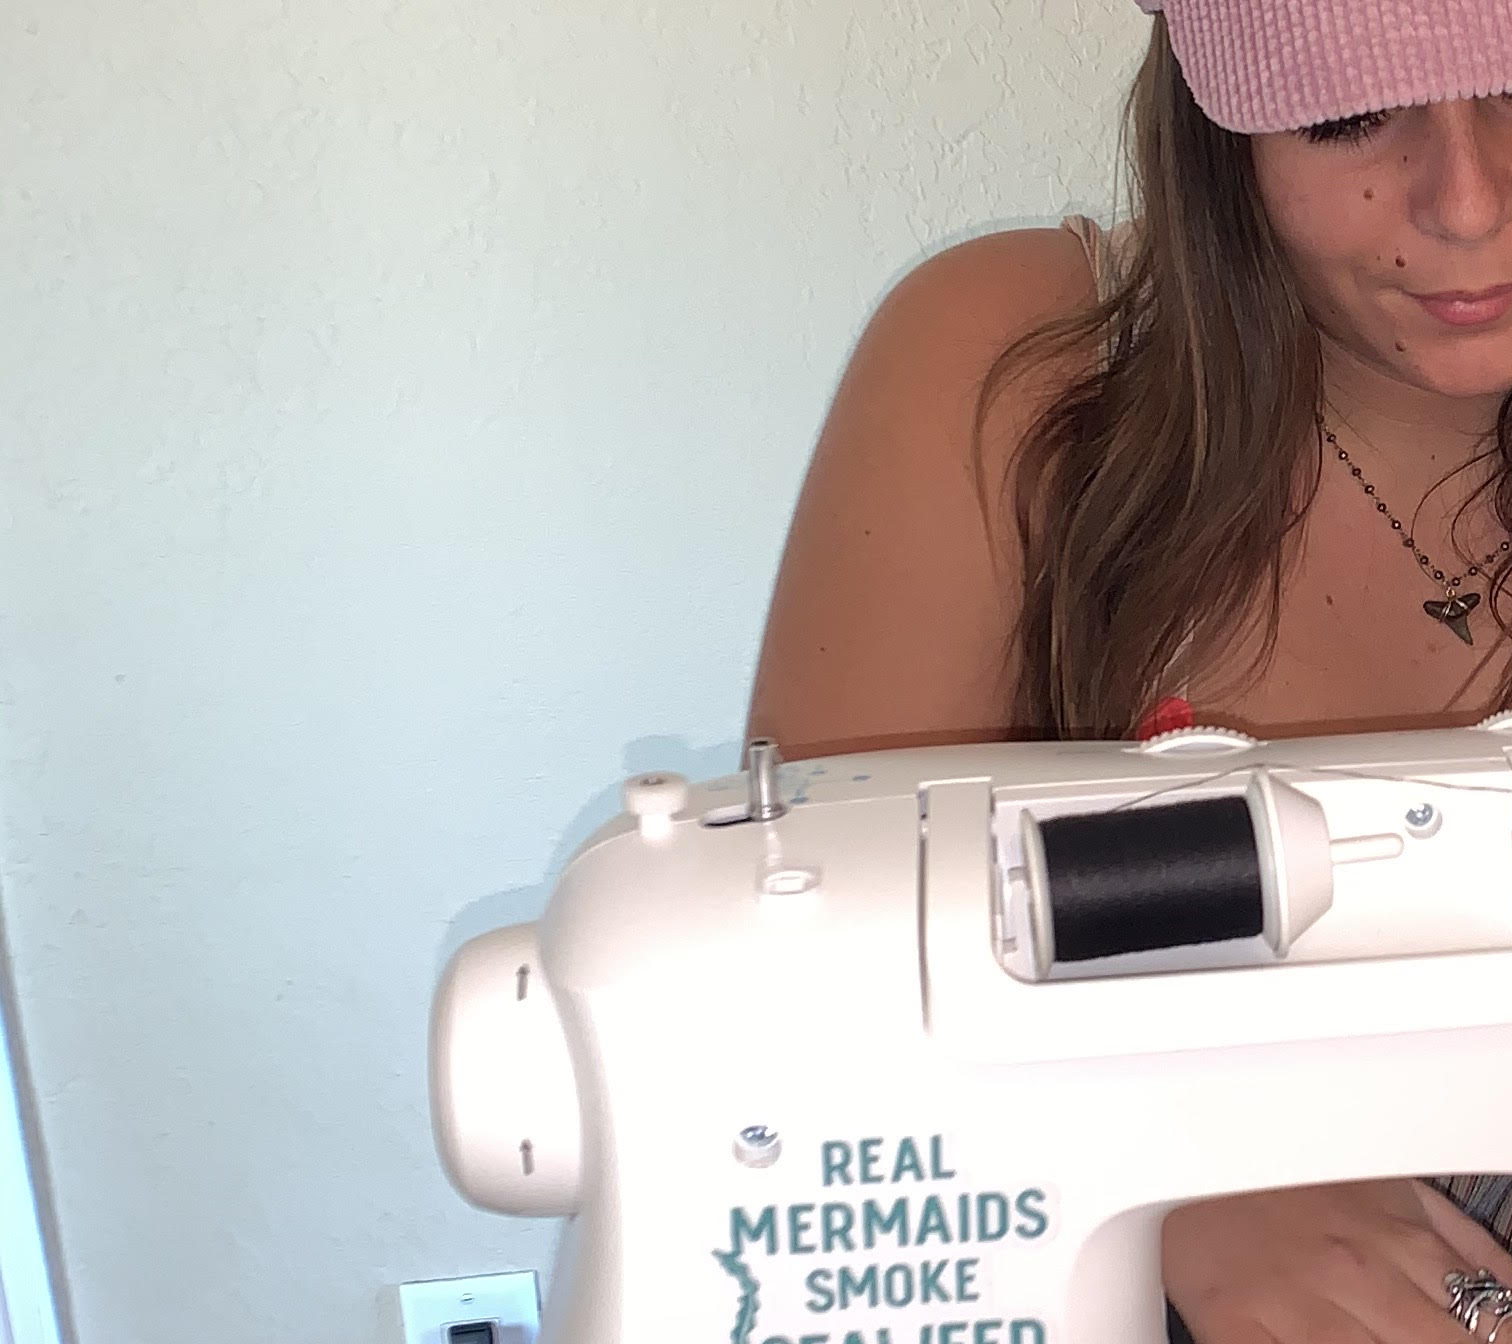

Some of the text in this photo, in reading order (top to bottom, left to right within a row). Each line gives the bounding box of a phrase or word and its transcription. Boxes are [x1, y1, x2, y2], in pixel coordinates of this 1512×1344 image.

[821, 1133, 957, 1187] REAL
[728, 1187, 1050, 1257] MERMAIDS
[804, 1256, 981, 1314] SMOKE
